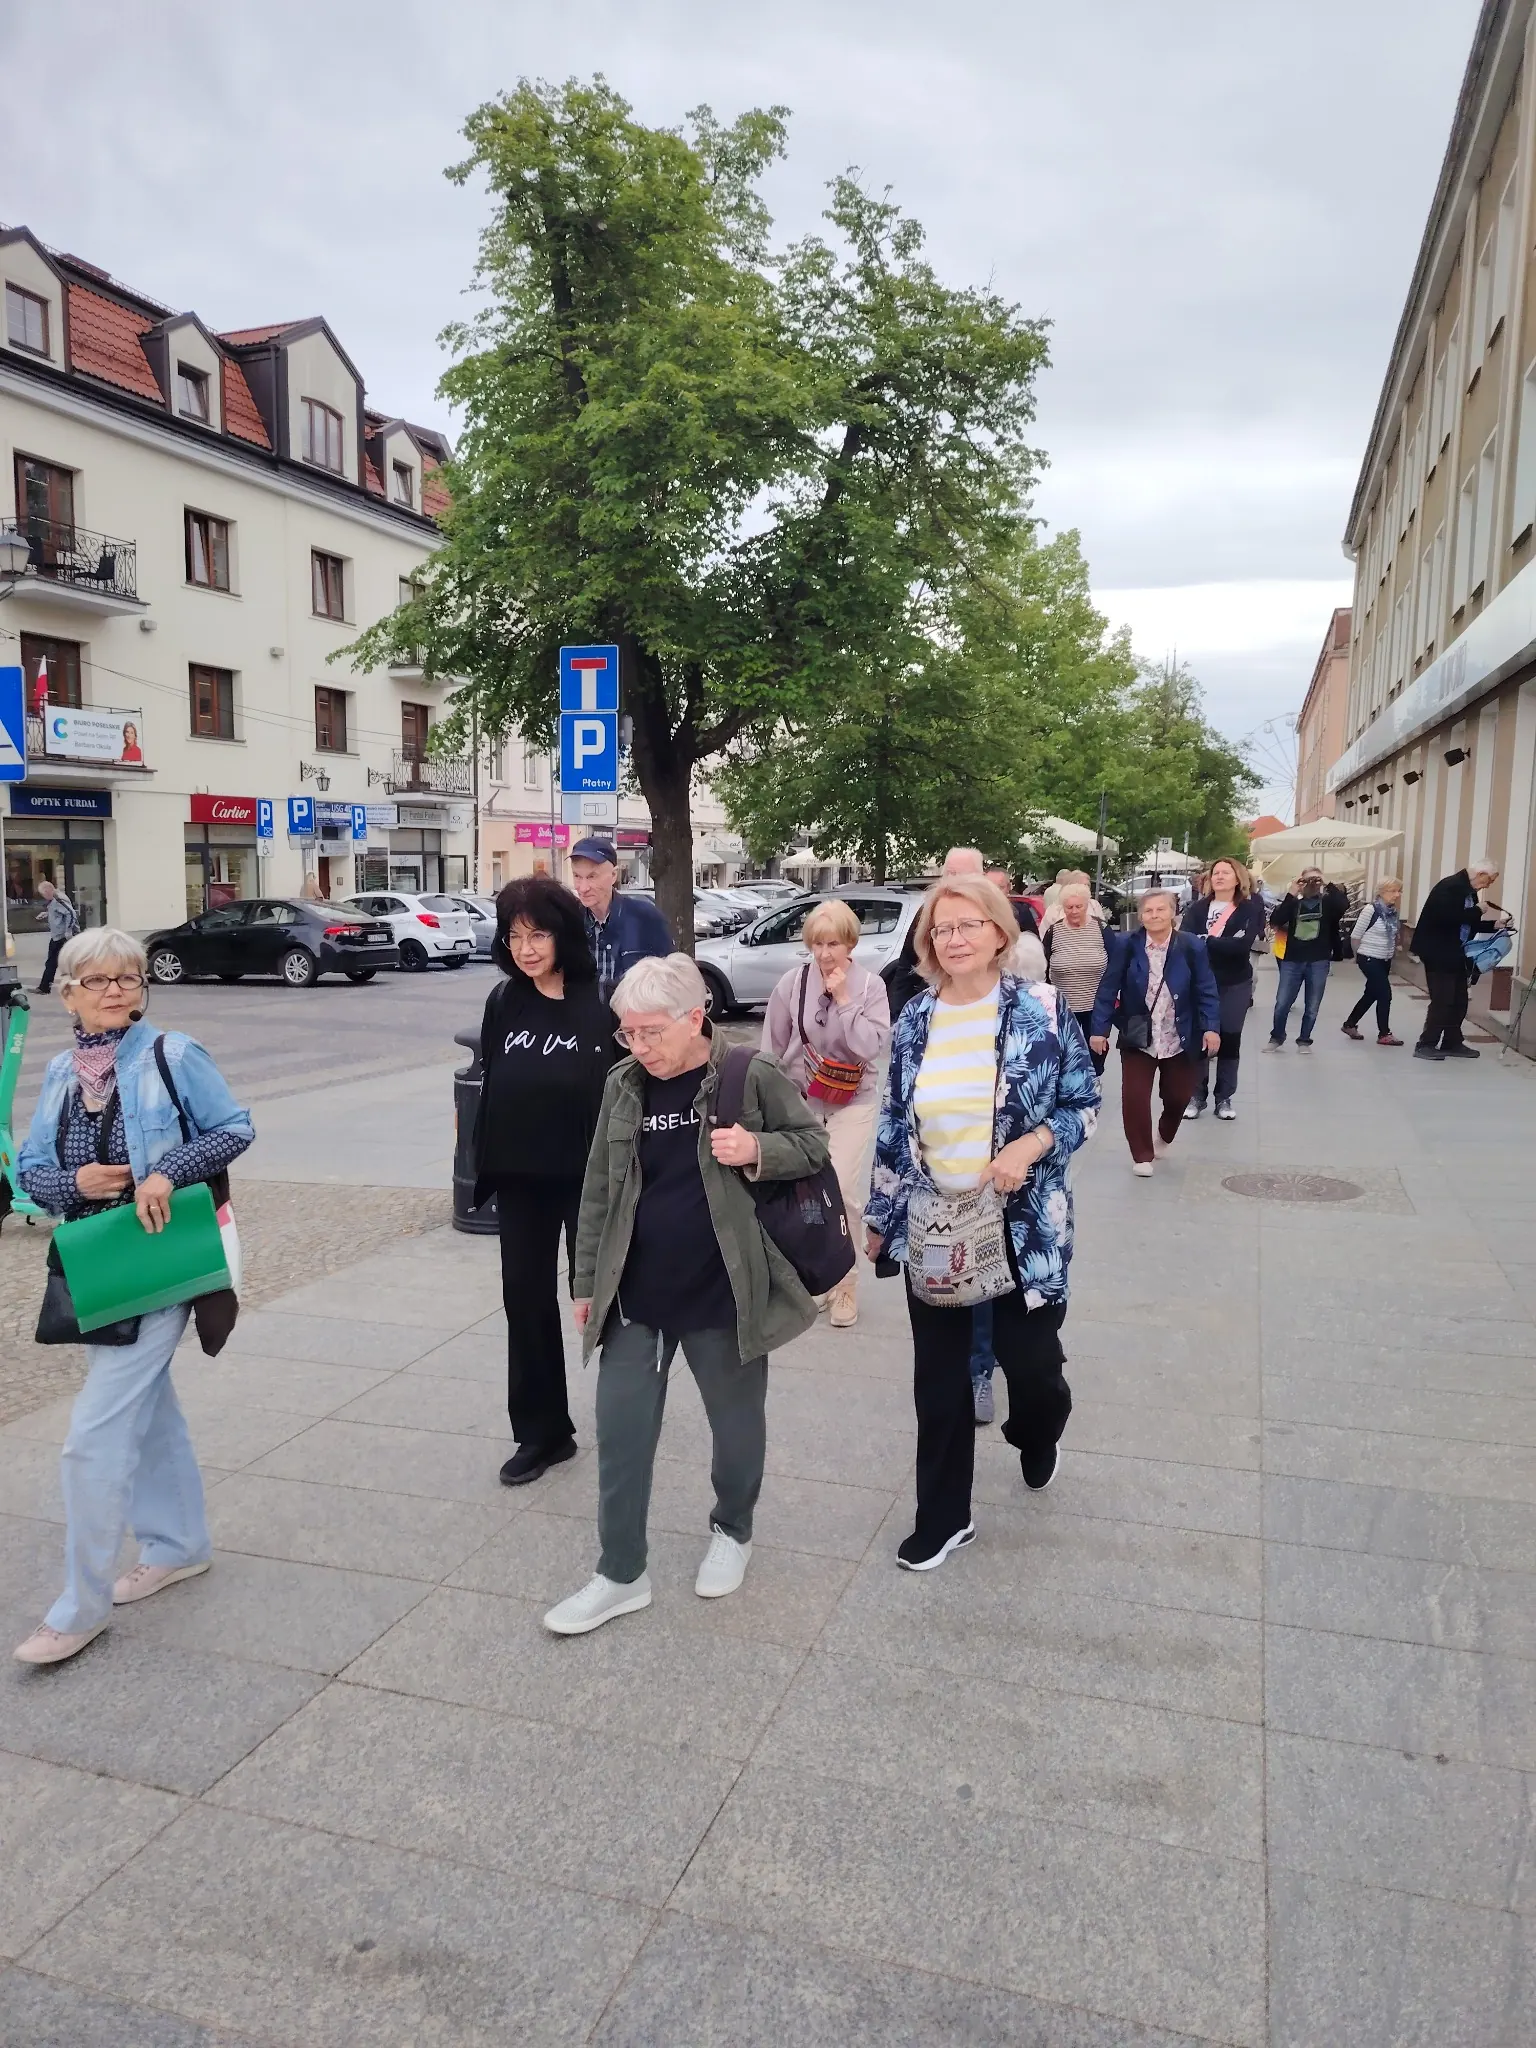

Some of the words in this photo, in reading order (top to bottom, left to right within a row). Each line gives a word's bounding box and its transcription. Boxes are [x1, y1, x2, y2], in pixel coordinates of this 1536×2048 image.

[73, 719, 91, 727] BIURO
[574, 720, 606, 769] P
[582, 779, 611, 789] Płatny
[30, 796, 62, 807] OPTYK
[64, 798, 98, 808] FURDAL
[211, 800, 251, 819] Cartier
[292, 799, 308, 824] P
[331, 803, 344, 813] USG
[260, 802, 271, 827] P
[354, 807, 365, 830] P
[504, 1030, 537, 1055] ça
